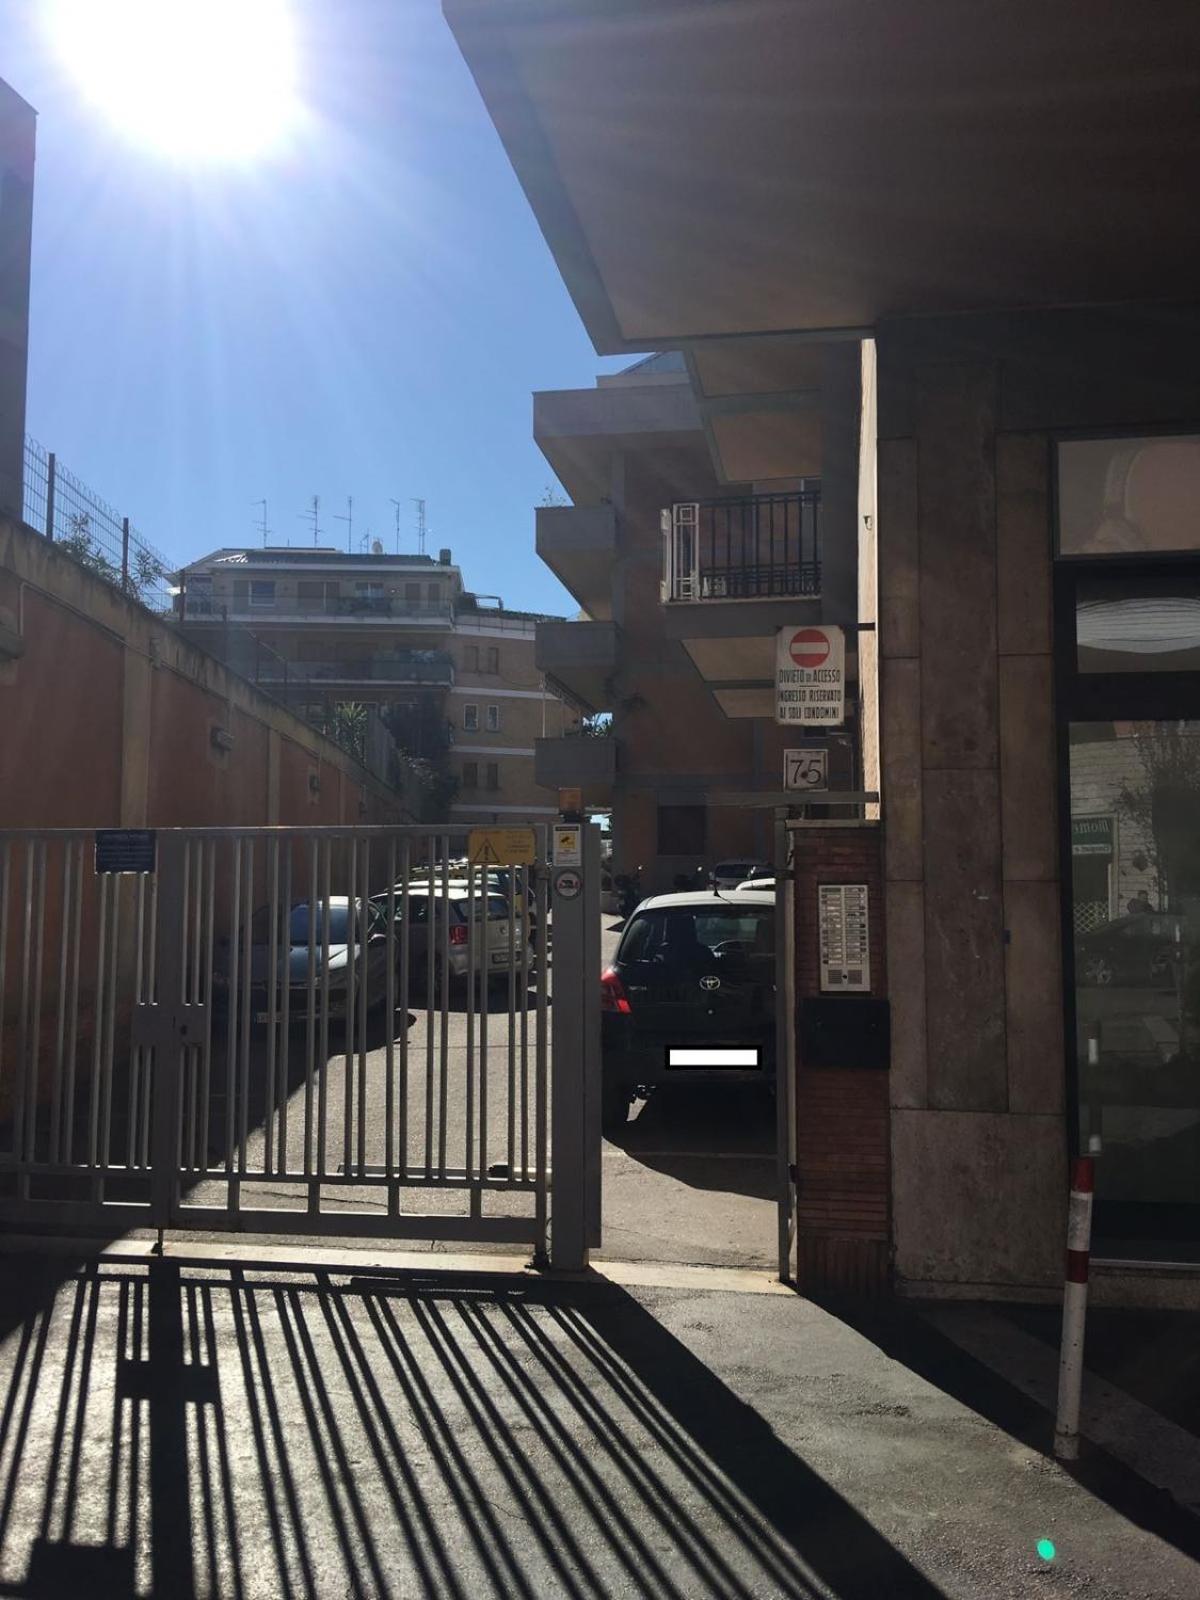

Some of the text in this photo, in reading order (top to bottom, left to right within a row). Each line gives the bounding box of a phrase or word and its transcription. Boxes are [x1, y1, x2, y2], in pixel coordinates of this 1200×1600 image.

[779, 669, 805, 683] DIVIETO
[813, 669, 840, 683] ACCESSO
[777, 690, 841, 702] INGRESSO RISERVATO
[779, 707, 839, 719] AI SOLI CONDOMINI
[789, 759, 822, 785] 75
